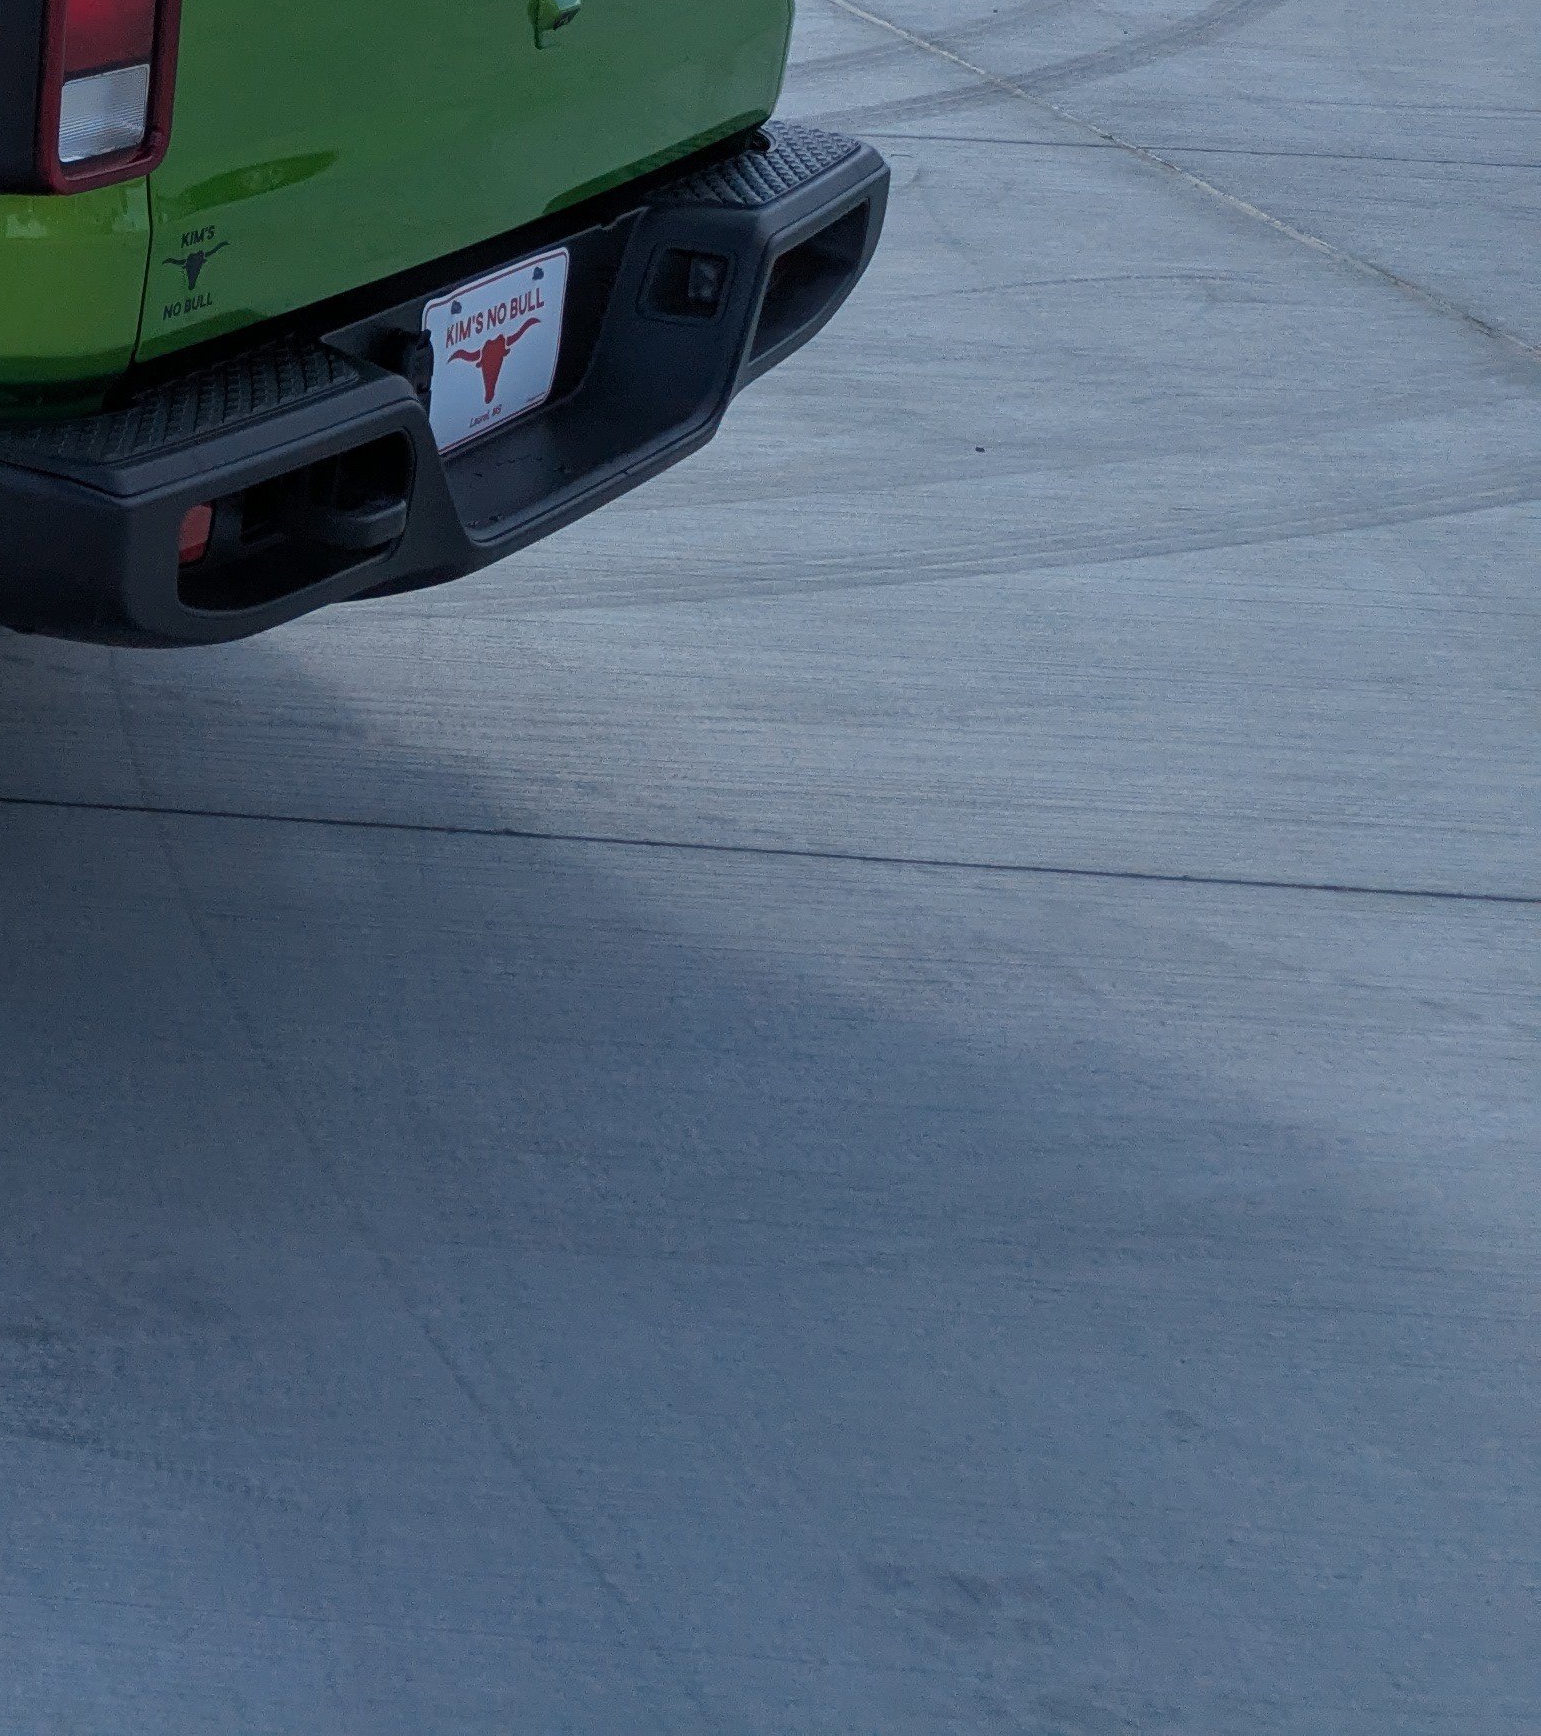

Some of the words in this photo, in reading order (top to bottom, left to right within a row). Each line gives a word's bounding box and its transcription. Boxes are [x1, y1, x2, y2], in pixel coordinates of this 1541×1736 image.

[181, 225, 215, 249] KIM'S
[163, 301, 182, 321] NO
[184, 292, 213, 314] BULL
[445, 311, 484, 349] KIM'S
[486, 301, 507, 331] NO
[509, 287, 545, 320] BULL
